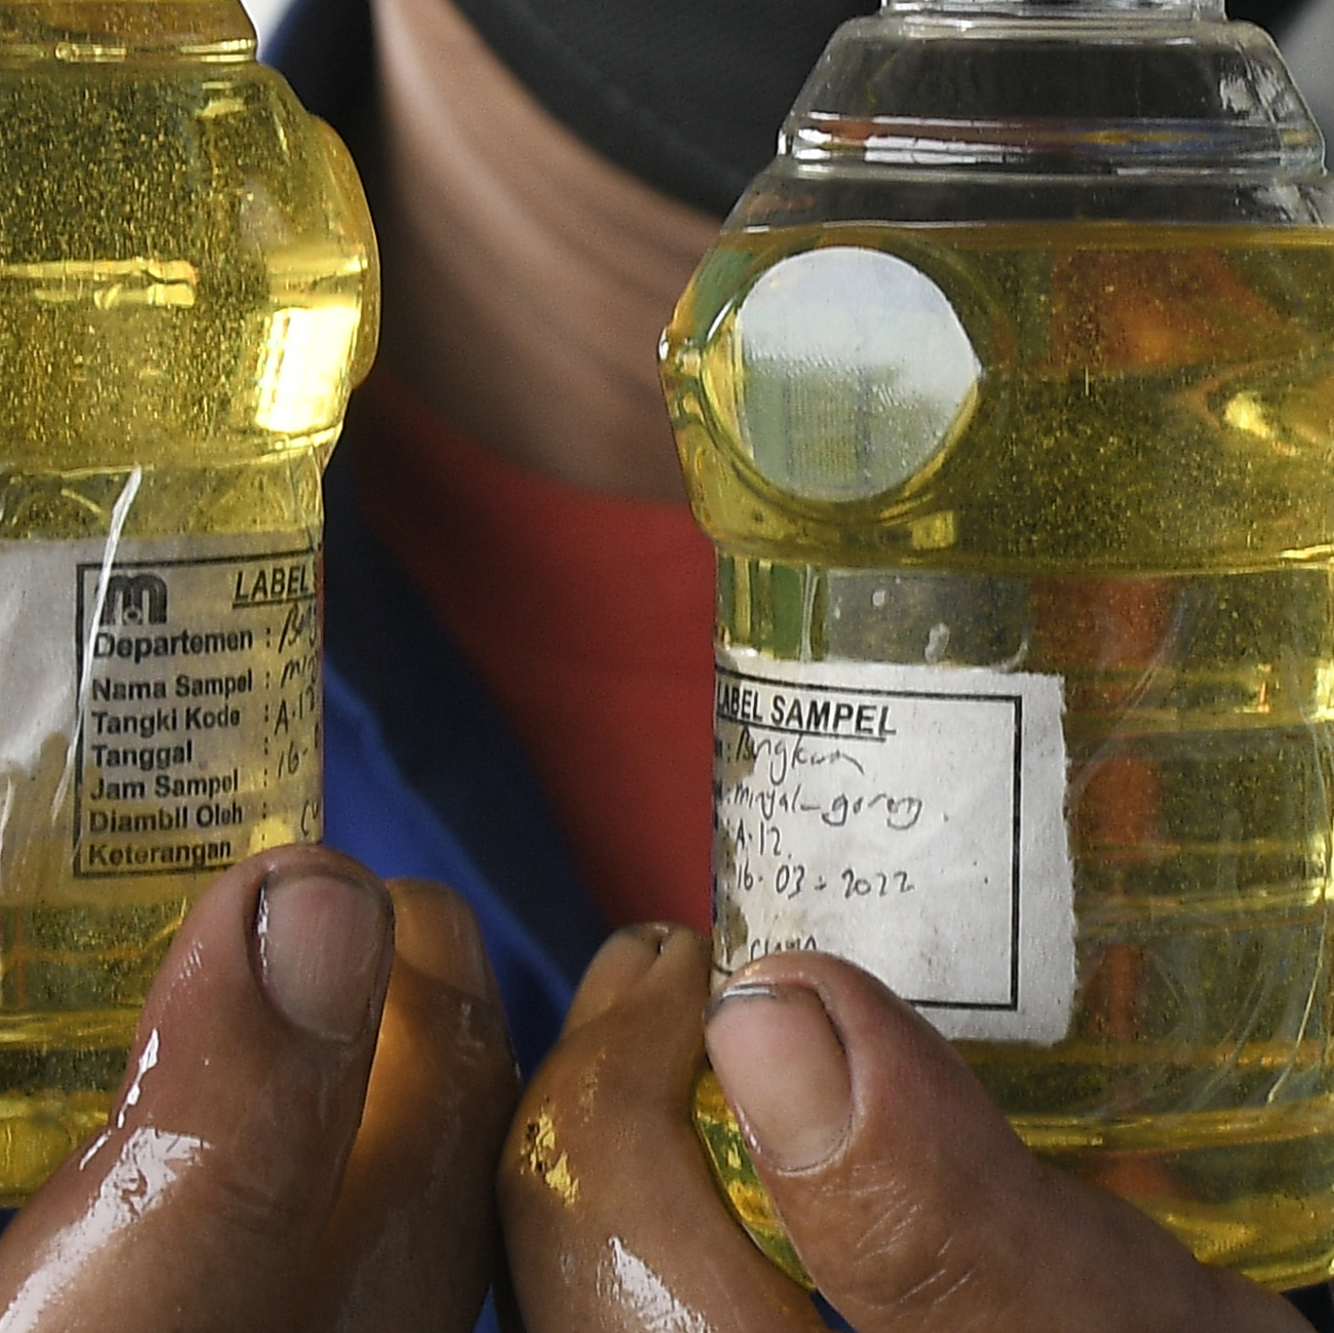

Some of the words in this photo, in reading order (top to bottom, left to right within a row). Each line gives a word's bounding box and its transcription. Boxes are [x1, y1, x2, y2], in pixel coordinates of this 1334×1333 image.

[234, 565, 309, 601] LABEL
[93, 627, 253, 664] Departemen
[91, 676, 166, 703] Nama
[175, 668, 253, 701] Sampel
[91, 708, 177, 738] Tangki
[185, 706, 241, 731] Kode
[718, 680, 763, 722] LABEL
[770, 694, 897, 736] SAMPEL
[91, 740, 193, 771] Tanggal
[91, 777, 145, 800] Jam
[155, 768, 239, 800] Sampel
[89, 806, 188, 833] Diambil
[196, 801, 243, 829] Oleh
[88, 839, 232, 867] Keterangan
